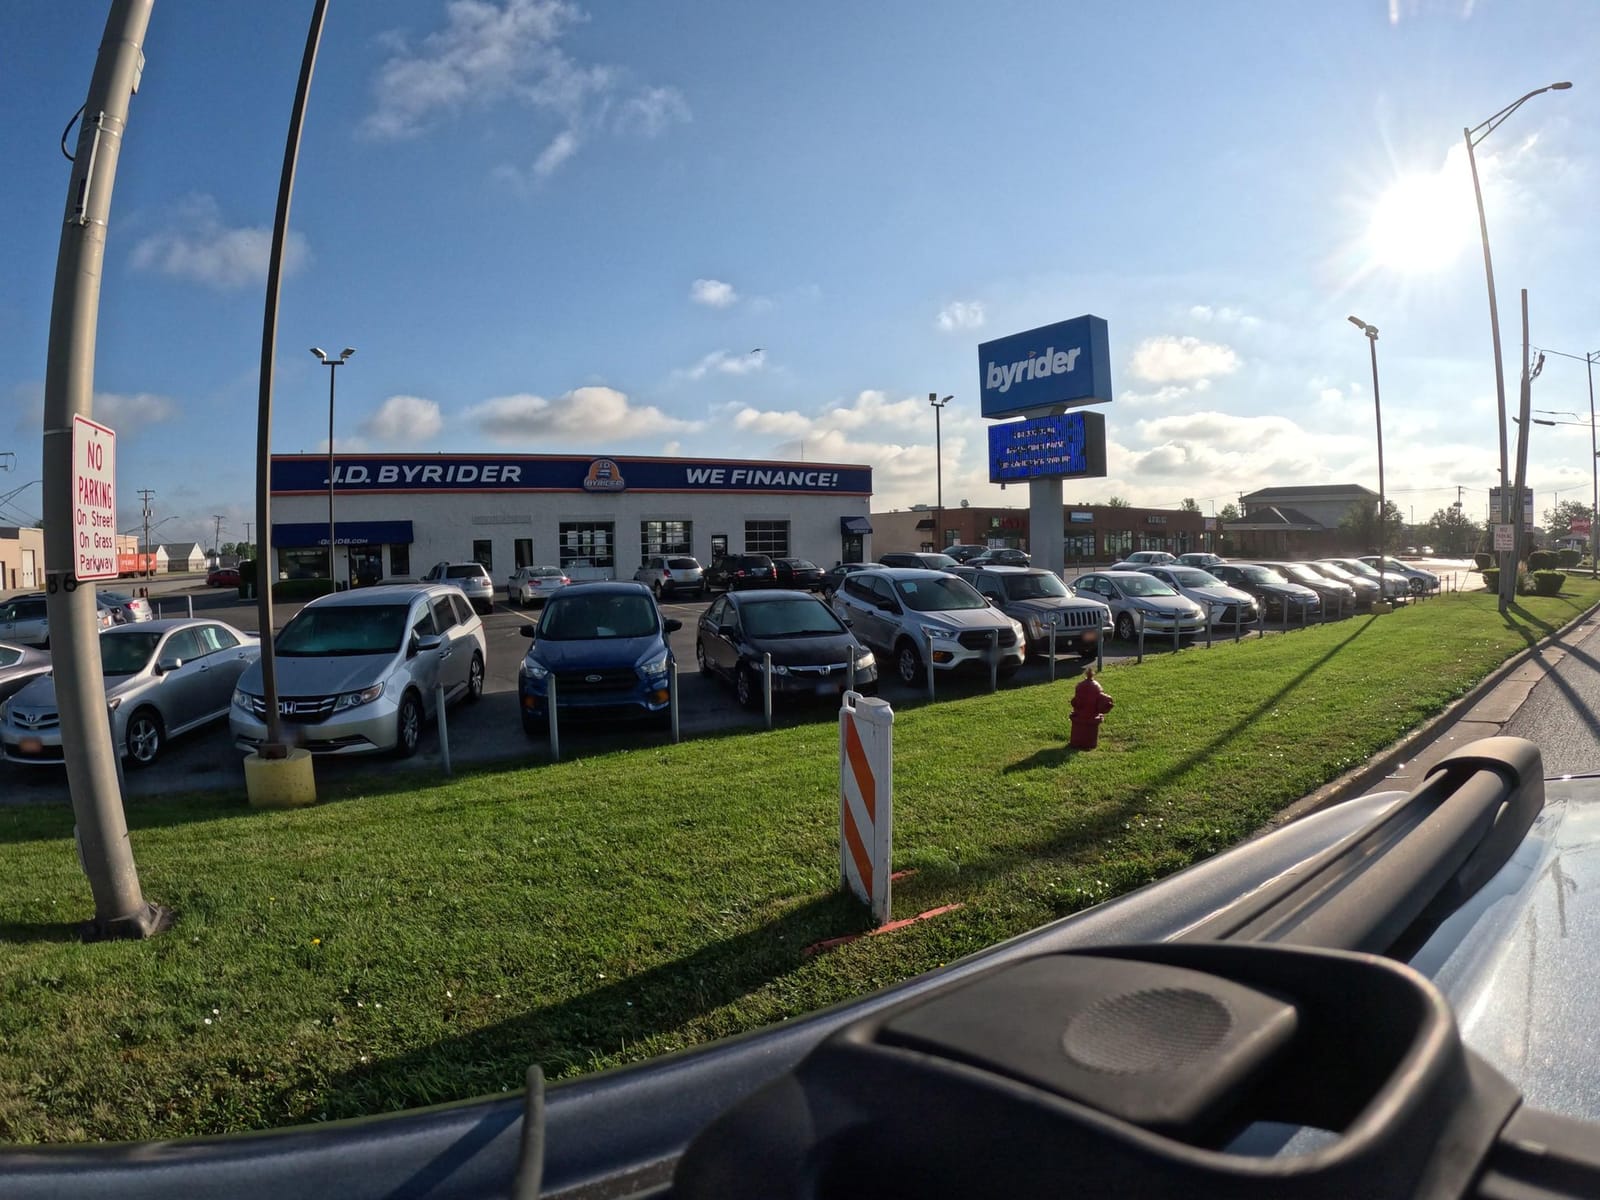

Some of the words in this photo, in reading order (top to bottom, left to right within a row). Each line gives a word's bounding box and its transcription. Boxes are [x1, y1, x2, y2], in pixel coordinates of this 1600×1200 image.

[986, 347, 1081, 393] byrider
[87, 440, 103, 471] NO
[377, 465, 522, 483] BYRIDER
[686, 468, 726, 484] WE
[731, 469, 839, 487] FINANCE!
[78, 476, 112, 509] PARKING
[77, 508, 87, 527] On
[91, 510, 114, 529] Street
[79, 531, 90, 549] On
[94, 532, 113, 549] Grass
[80, 554, 114, 573] Parkway
